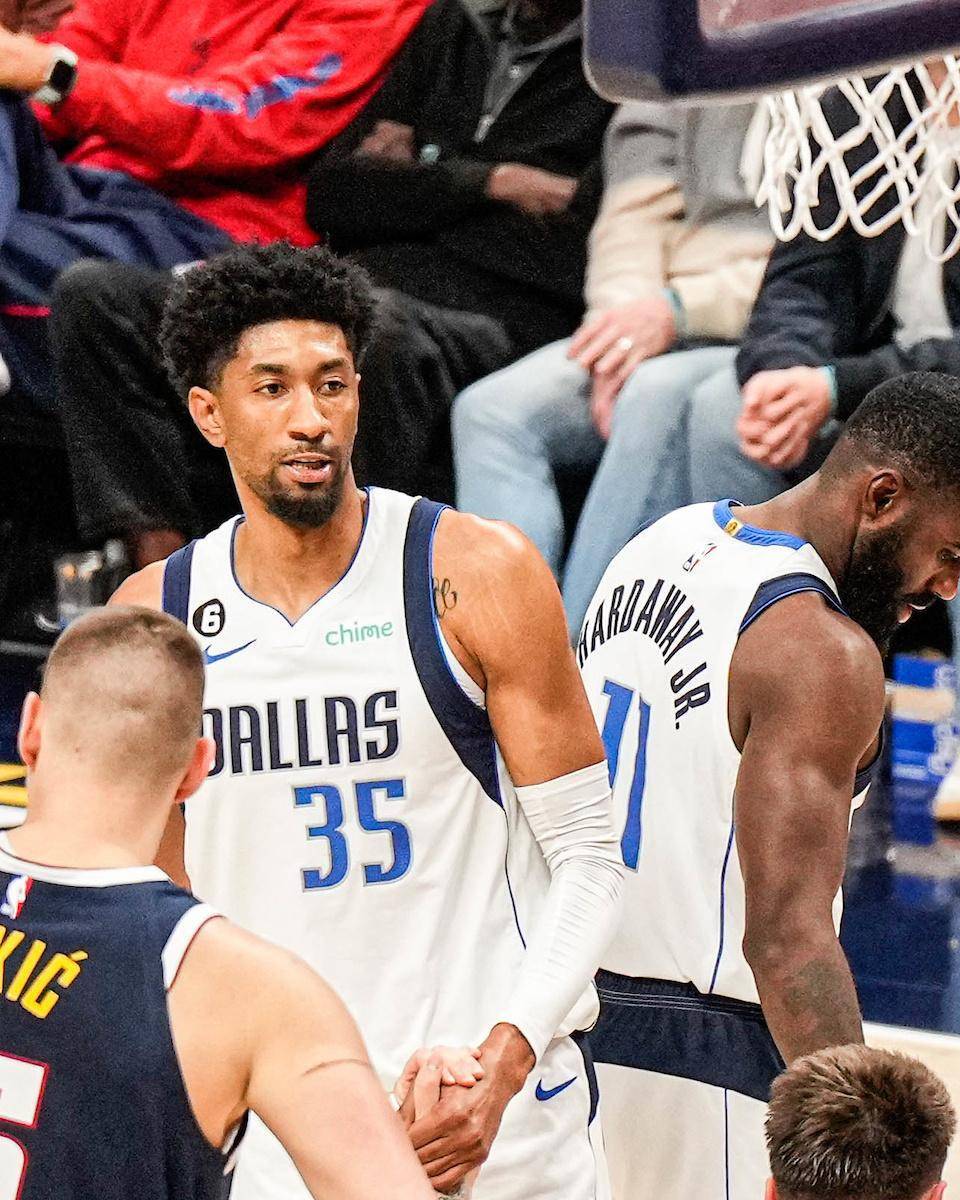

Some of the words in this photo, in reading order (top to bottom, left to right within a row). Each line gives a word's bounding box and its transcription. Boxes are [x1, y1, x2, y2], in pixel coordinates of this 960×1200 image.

[198, 600, 224, 637] 6
[325, 621, 393, 646] chime
[578, 578, 704, 669] HARDAWAY
[670, 661, 711, 730] JR.
[292, 776, 414, 893] 35
